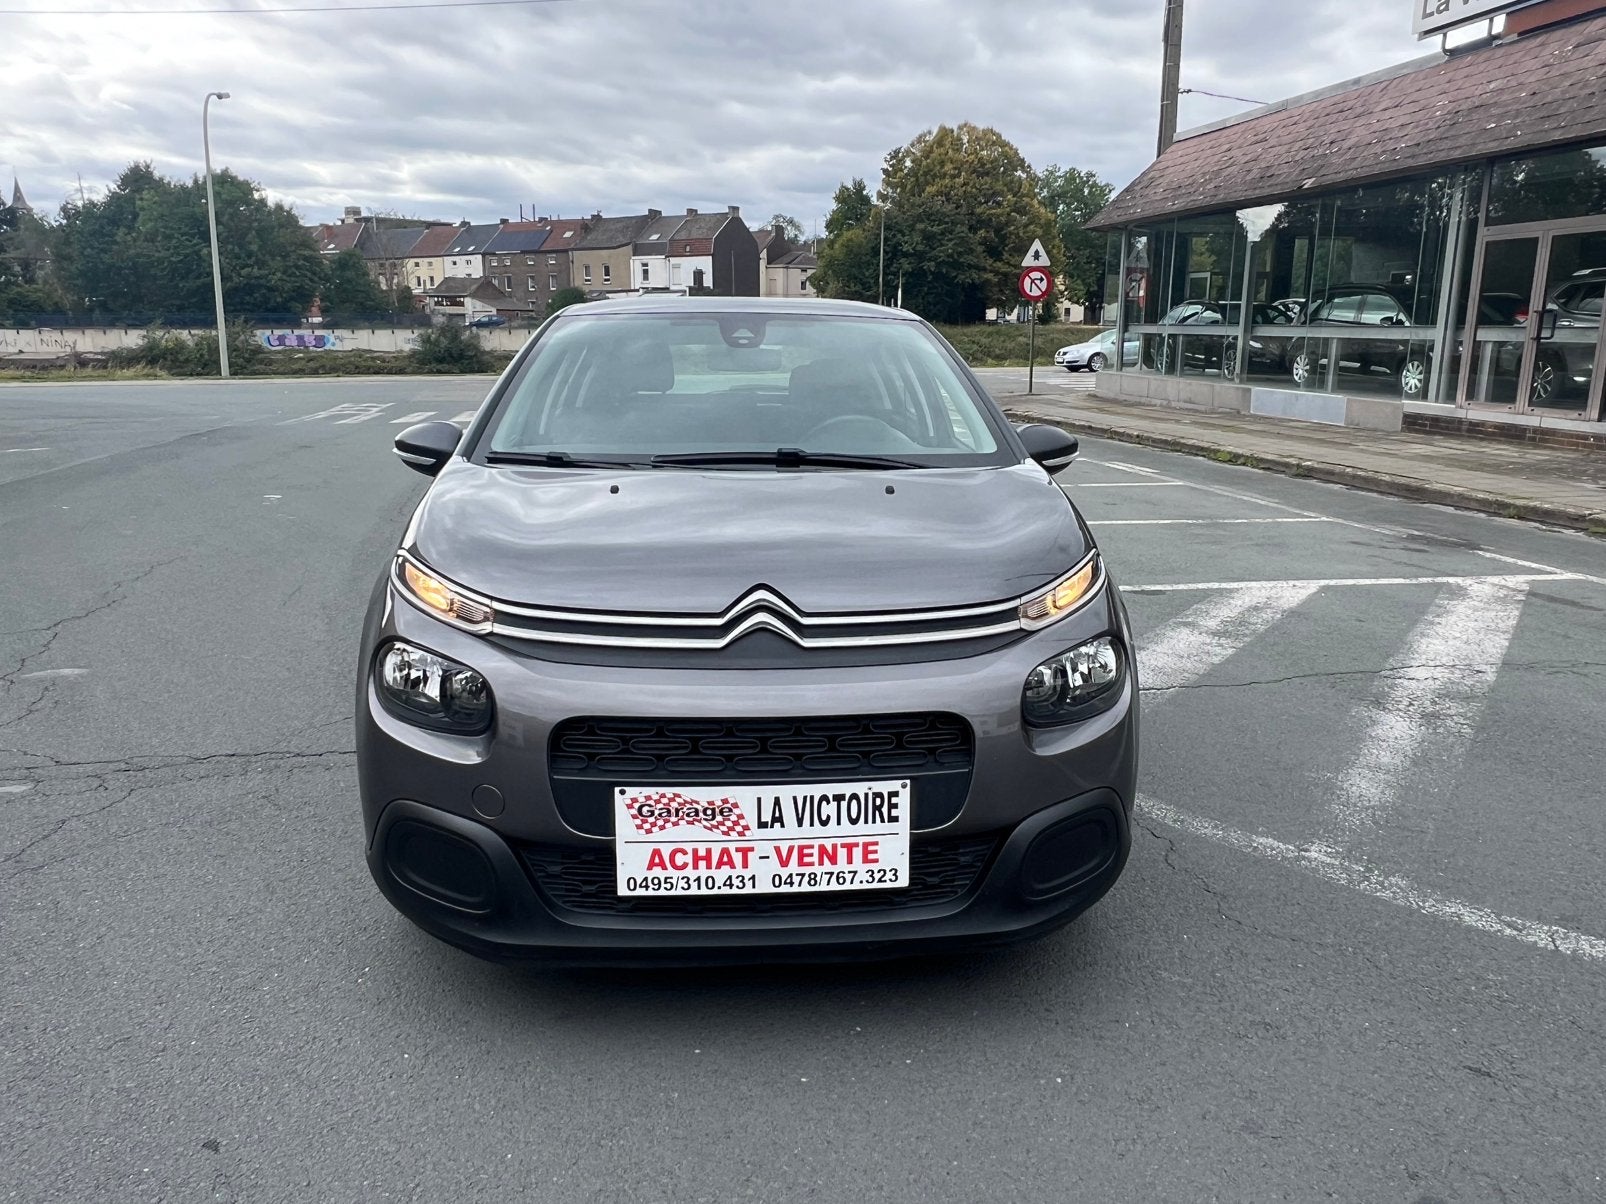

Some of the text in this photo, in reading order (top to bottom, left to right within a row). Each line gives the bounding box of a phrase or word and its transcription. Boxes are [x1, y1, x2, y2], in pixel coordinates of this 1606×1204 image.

[637, 790, 900, 829] Garage LA VICTOIRE
[626, 867, 900, 892] 0495/310.431 0478/767.323
